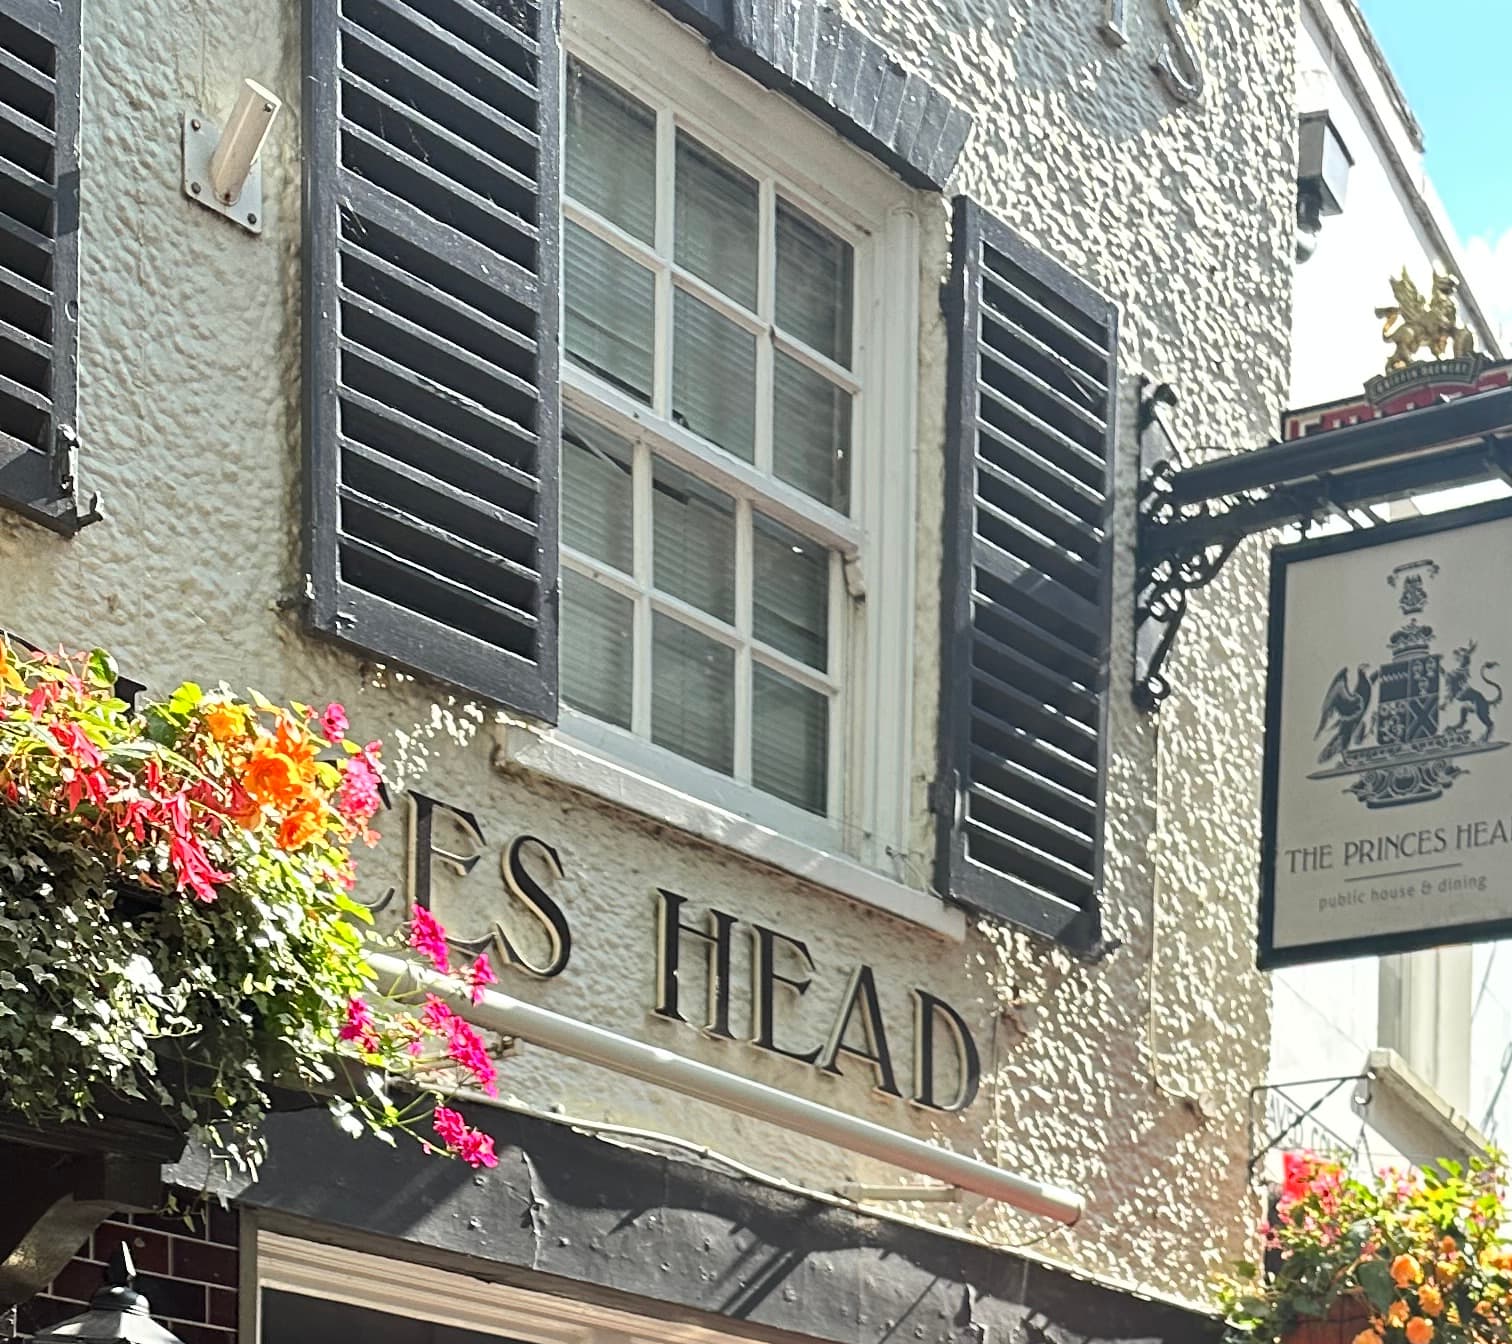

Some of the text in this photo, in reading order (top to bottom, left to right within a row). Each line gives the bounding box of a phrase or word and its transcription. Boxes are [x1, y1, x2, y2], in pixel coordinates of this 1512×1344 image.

[1285, 843, 1333, 873] THE
[1343, 828, 1447, 866] PRINCES
[1318, 889, 1367, 912] public
[1371, 884, 1415, 901] house
[1438, 874, 1488, 892] dining
[652, 886, 983, 1114] HEAD
